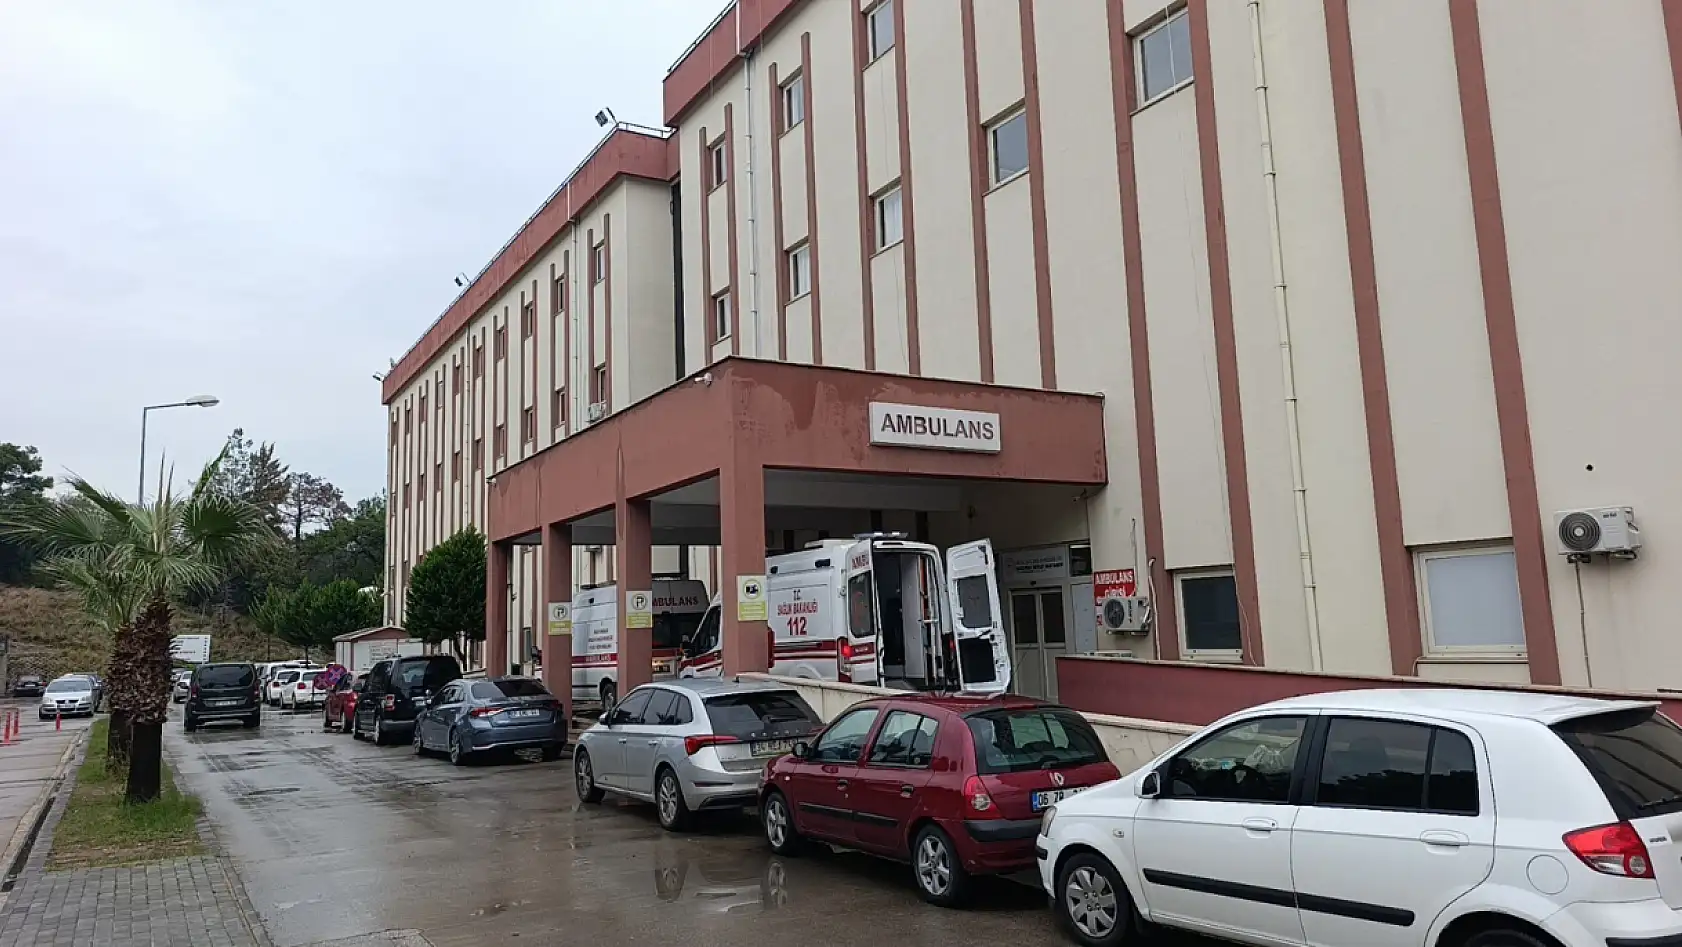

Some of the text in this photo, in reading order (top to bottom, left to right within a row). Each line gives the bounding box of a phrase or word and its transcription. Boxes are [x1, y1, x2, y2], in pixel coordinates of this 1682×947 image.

[881, 413, 994, 440] AMBULANS
[1096, 571, 1133, 585] AMBULANS
[652, 596, 699, 606] MBULANS
[787, 616, 808, 636] 112
